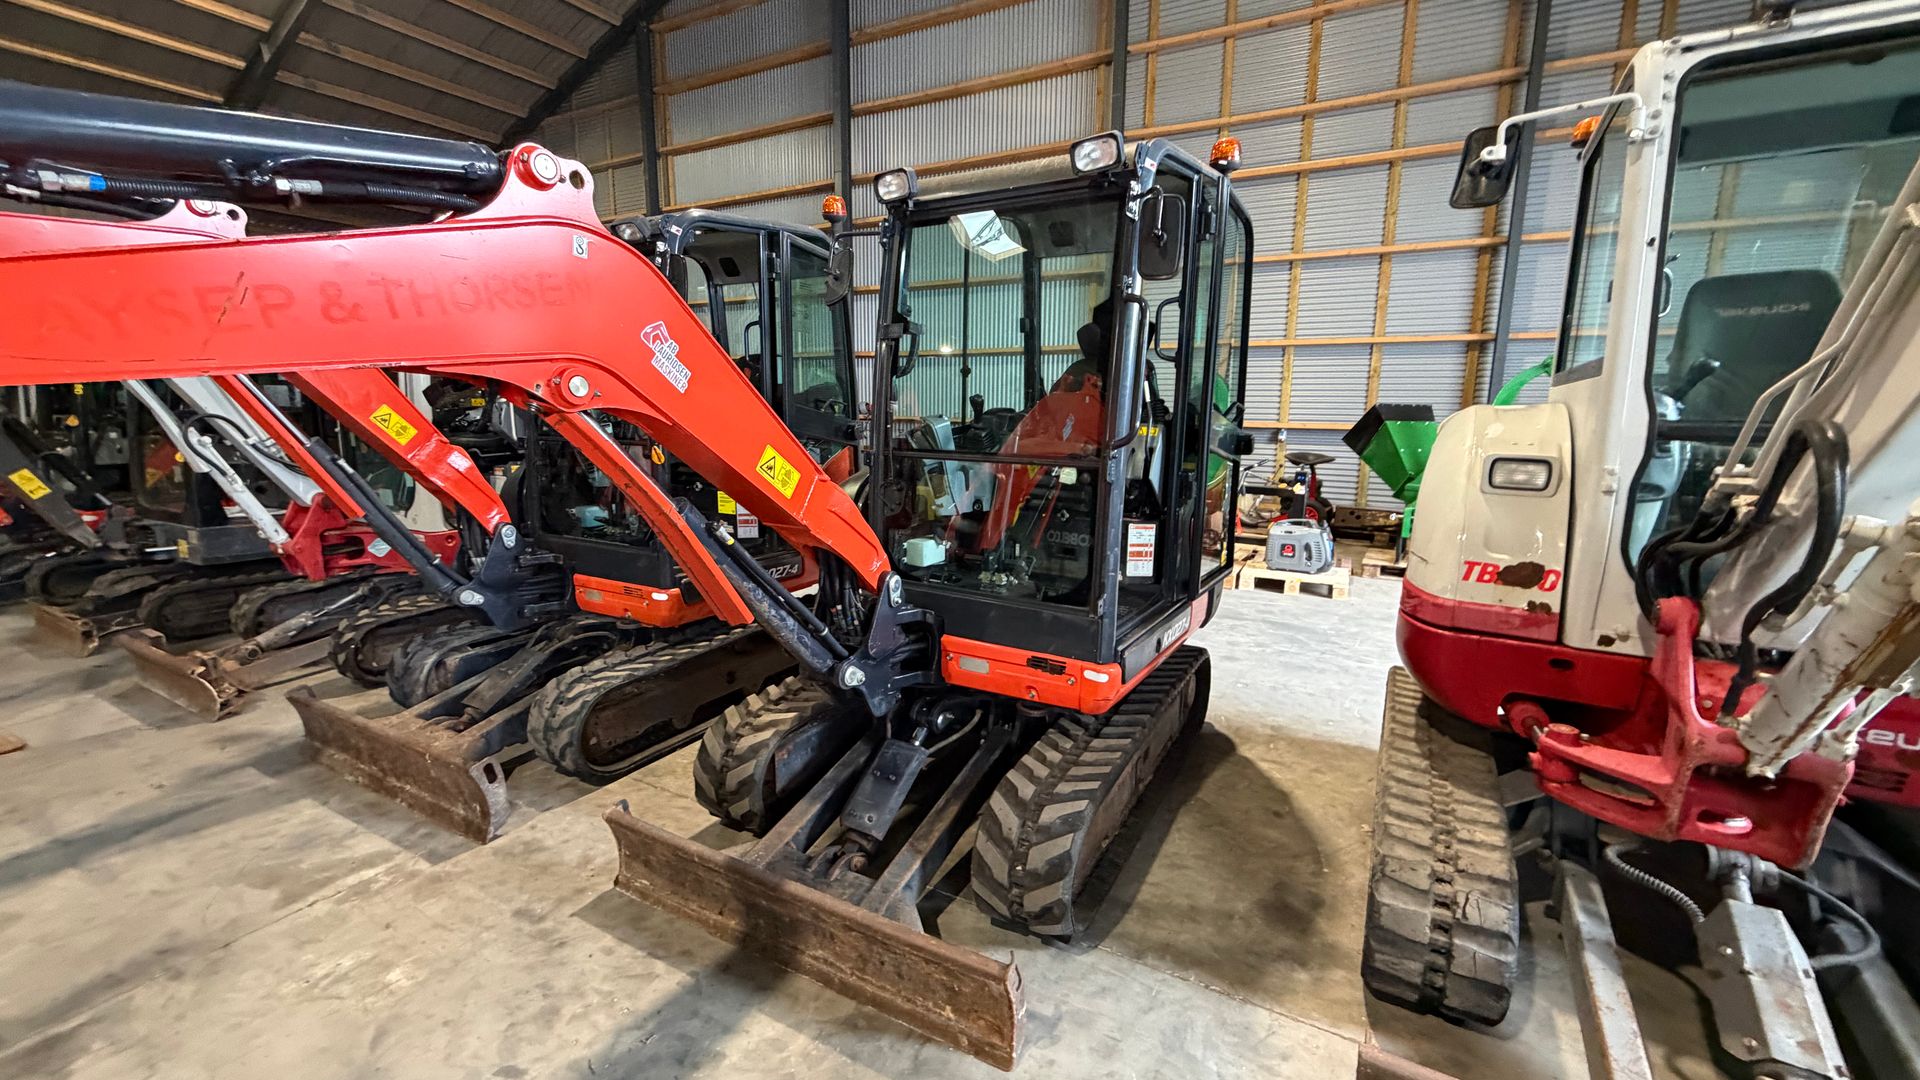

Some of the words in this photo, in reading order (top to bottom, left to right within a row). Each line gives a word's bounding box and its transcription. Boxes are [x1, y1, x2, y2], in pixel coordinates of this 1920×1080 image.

[319, 280, 368, 324] &
[653, 341, 691, 381] LAURIDSEN
[666, 341, 679, 355] AB
[652, 355, 688, 392] MASKINER
[1461, 560, 1562, 592] TB0
[1859, 727, 1920, 751] eu
